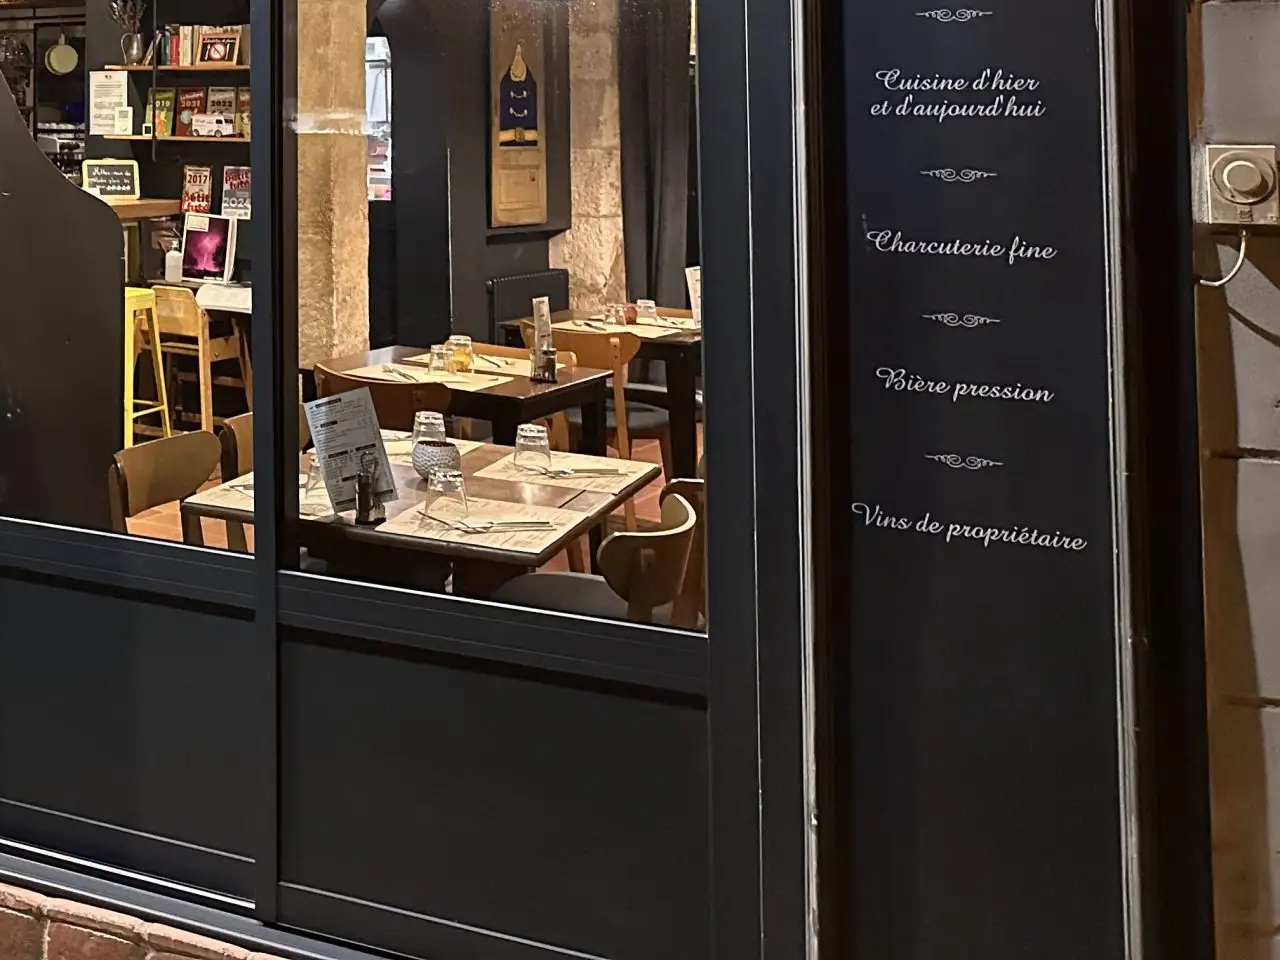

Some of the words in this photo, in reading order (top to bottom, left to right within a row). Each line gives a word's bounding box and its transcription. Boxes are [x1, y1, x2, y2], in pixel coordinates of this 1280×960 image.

[875, 69, 968, 91] Cuisine
[972, 69, 1039, 92] d'hier
[870, 99, 892, 116] et
[895, 94, 1046, 123] d'aujourd'hui
[187, 174, 208, 184] 2017
[867, 230, 1005, 257] Charcuterie
[1007, 236, 1057, 265] fine
[876, 366, 951, 394] Bière
[952, 379, 1054, 403] pression
[851, 502, 912, 530] Vins
[916, 513, 944, 534] de
[946, 519, 1087, 551] propriétaire
